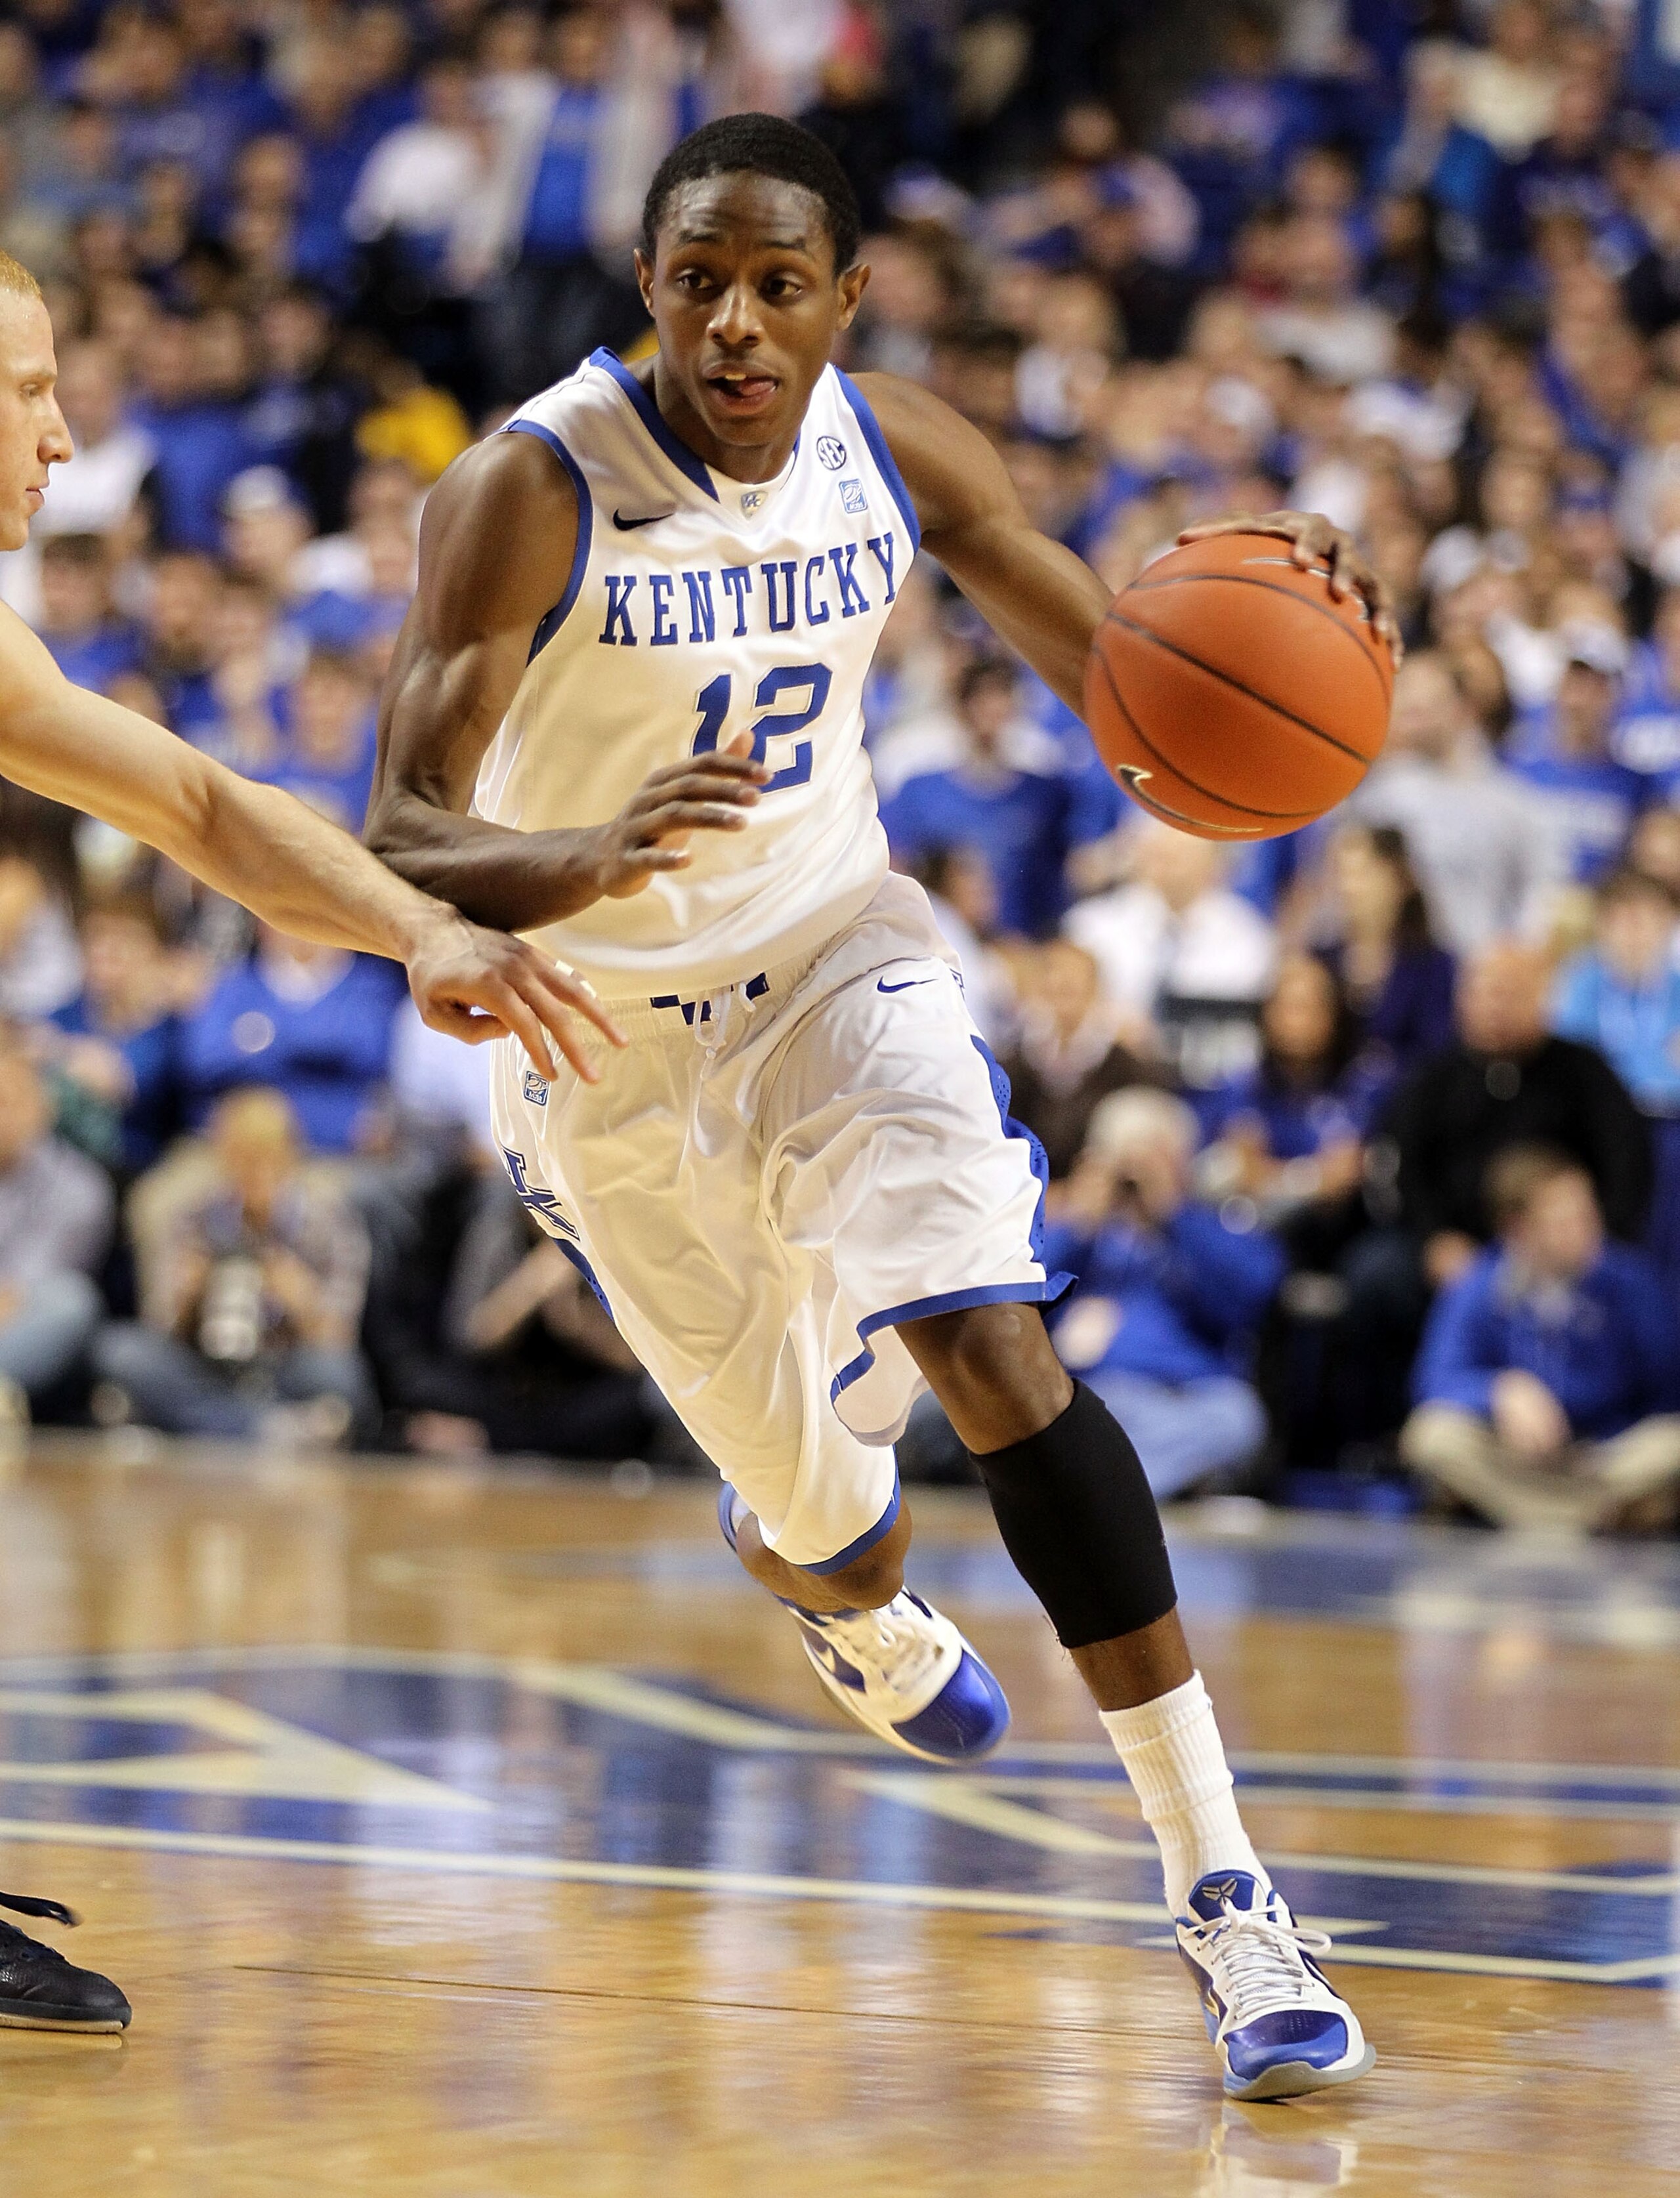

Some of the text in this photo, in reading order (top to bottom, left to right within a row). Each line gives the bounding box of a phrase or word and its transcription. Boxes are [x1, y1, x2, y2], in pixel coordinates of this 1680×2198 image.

[817, 436, 847, 470] SEC
[599, 532, 895, 646] KENTUCKY
[693, 663, 833, 793] 12
